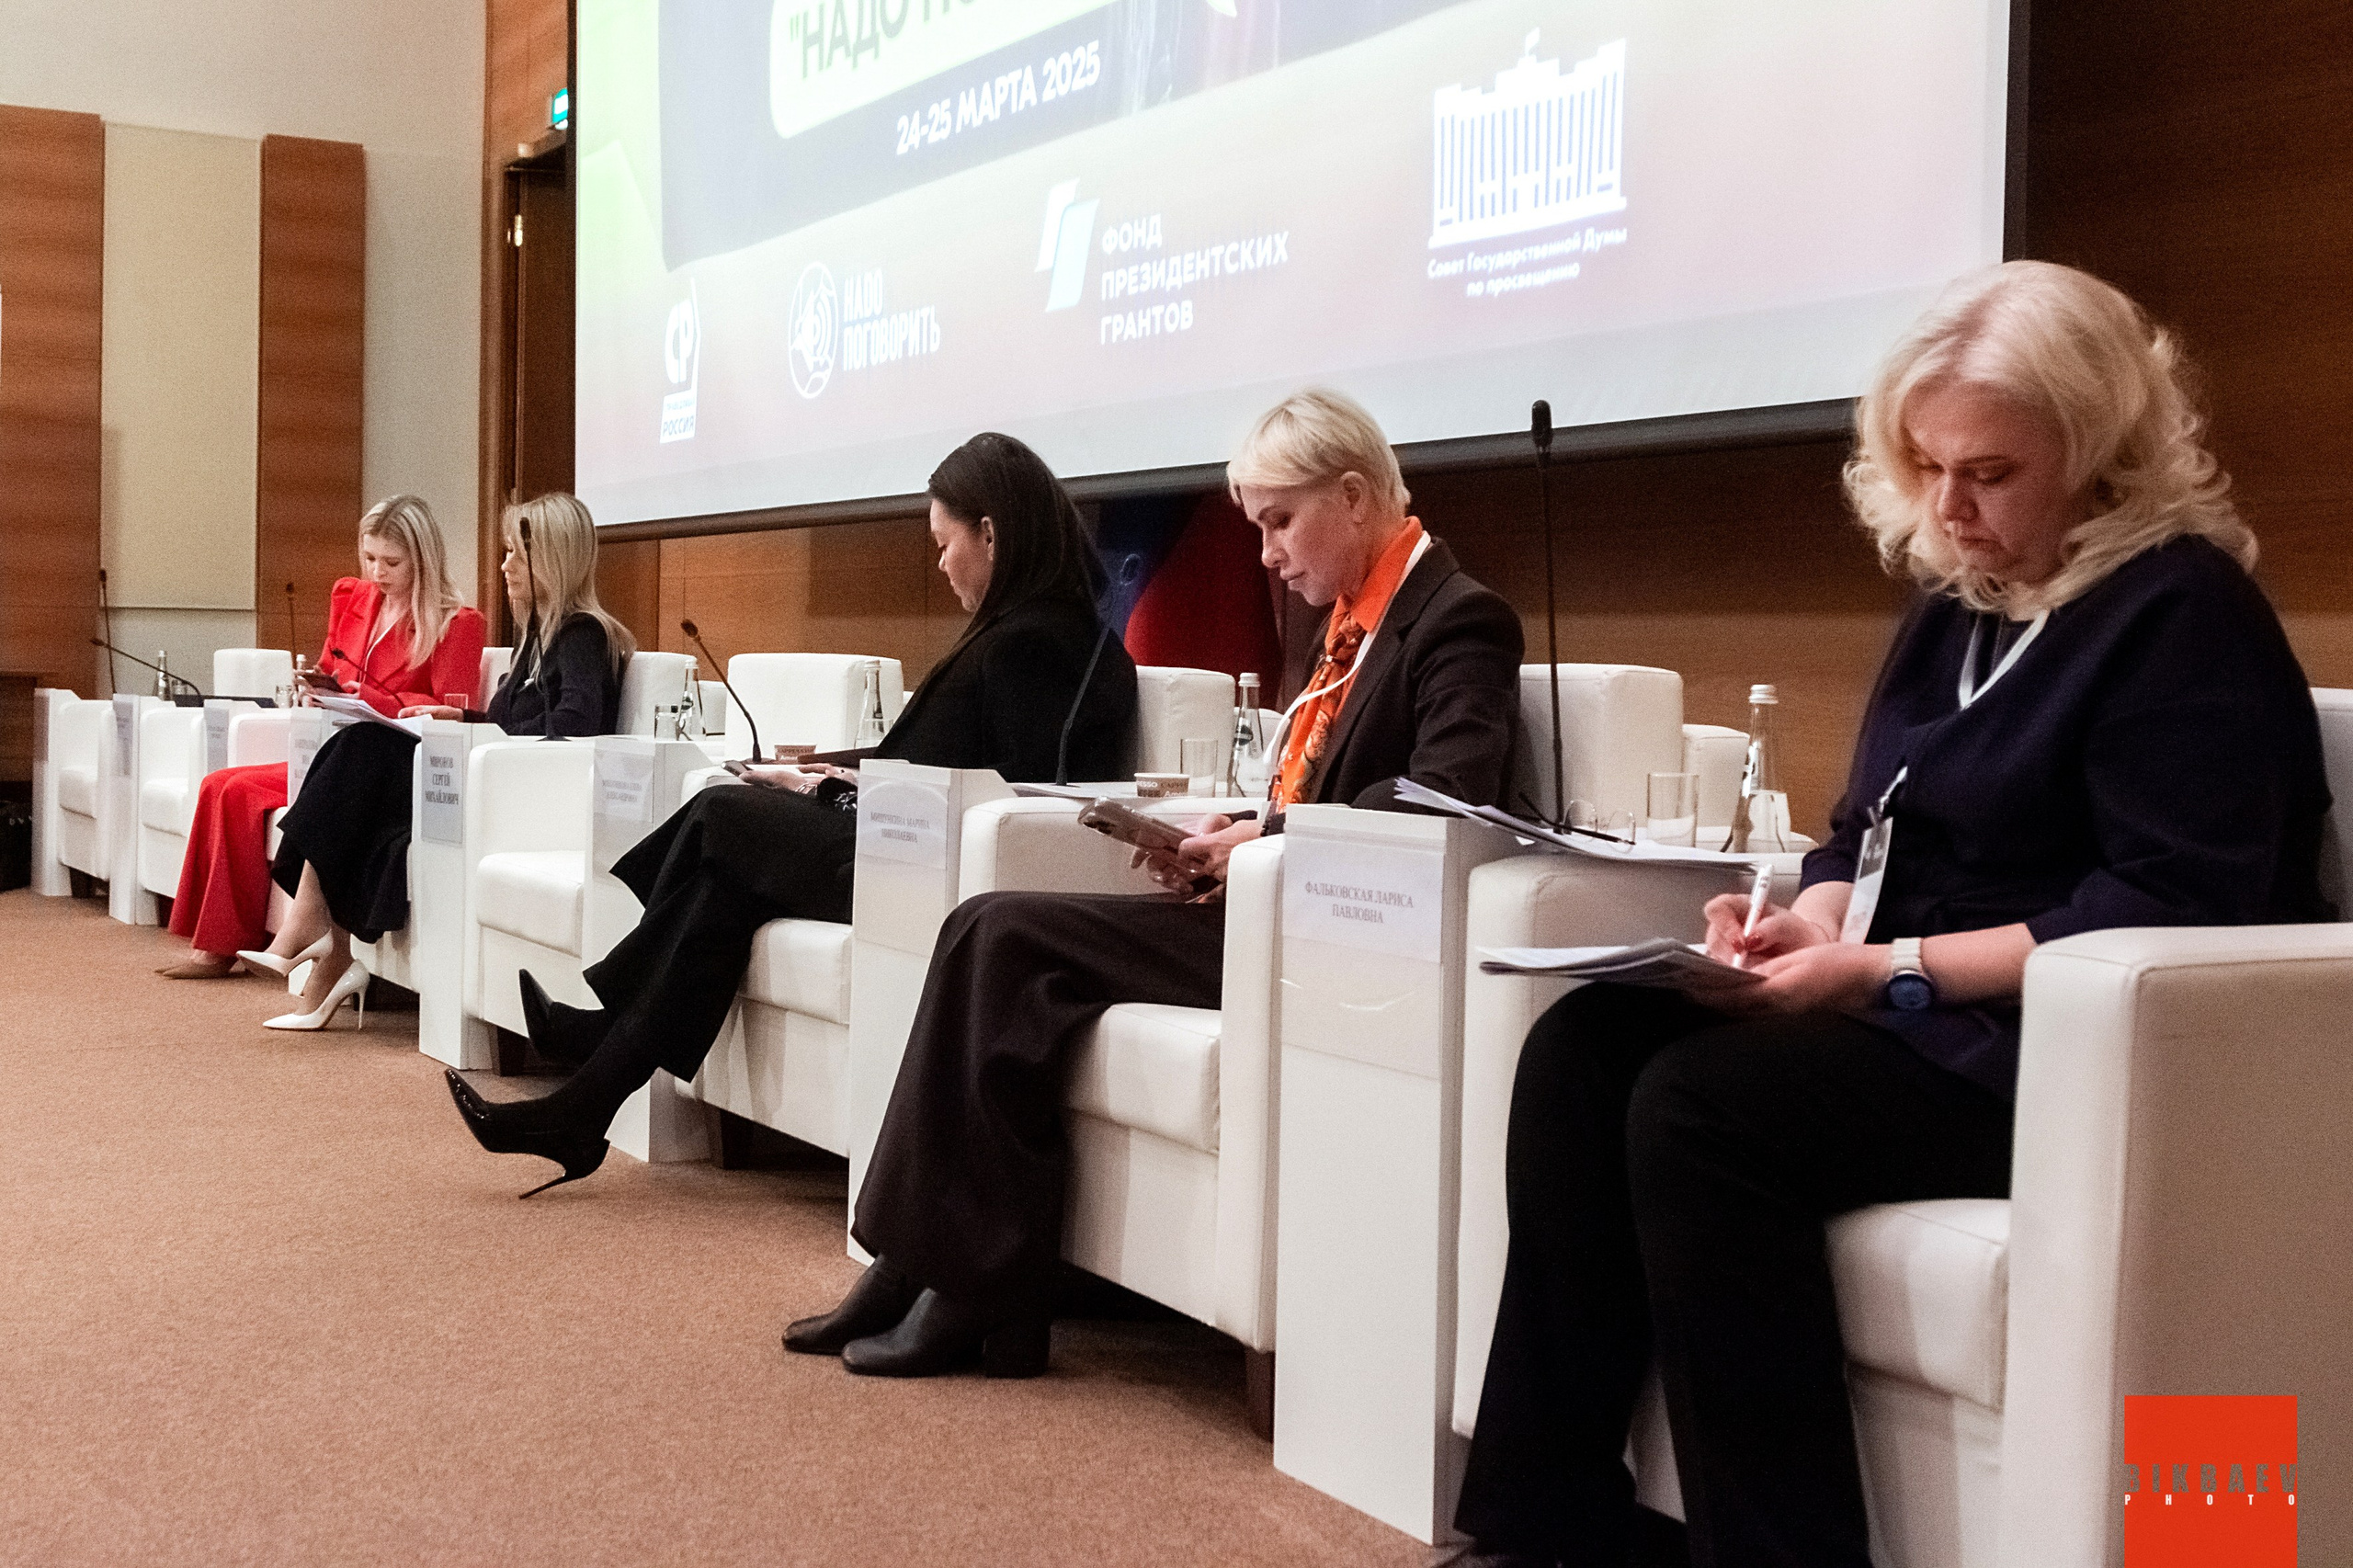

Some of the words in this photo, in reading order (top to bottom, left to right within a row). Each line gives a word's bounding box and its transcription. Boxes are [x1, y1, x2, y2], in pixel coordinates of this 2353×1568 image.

[896, 98, 952, 155] 24-25
[956, 65, 1038, 134] МАРТА
[1042, 40, 1101, 103] 2025
[1102, 213, 1163, 256] ФОНД
[1427, 258, 1465, 278] Совет
[1467, 232, 1582, 273] Государственной
[1582, 227, 1628, 254] Думы
[1102, 232, 1290, 301] ПРЕЗИДЕНТСКИХ
[1466, 280, 1485, 298] по
[1485, 262, 1581, 297] просвещению
[843, 305, 941, 371] ПОГОВОРИТЬ
[1100, 300, 1194, 346] ГРАНТОВ
[663, 415, 695, 437] РОССИЯ
[1304, 881, 1374, 903] ФАЛЬКОВСКАЯ
[1375, 890, 1414, 908] ЛАРИСА
[1332, 903, 1384, 924] ПАВЛОВНА
